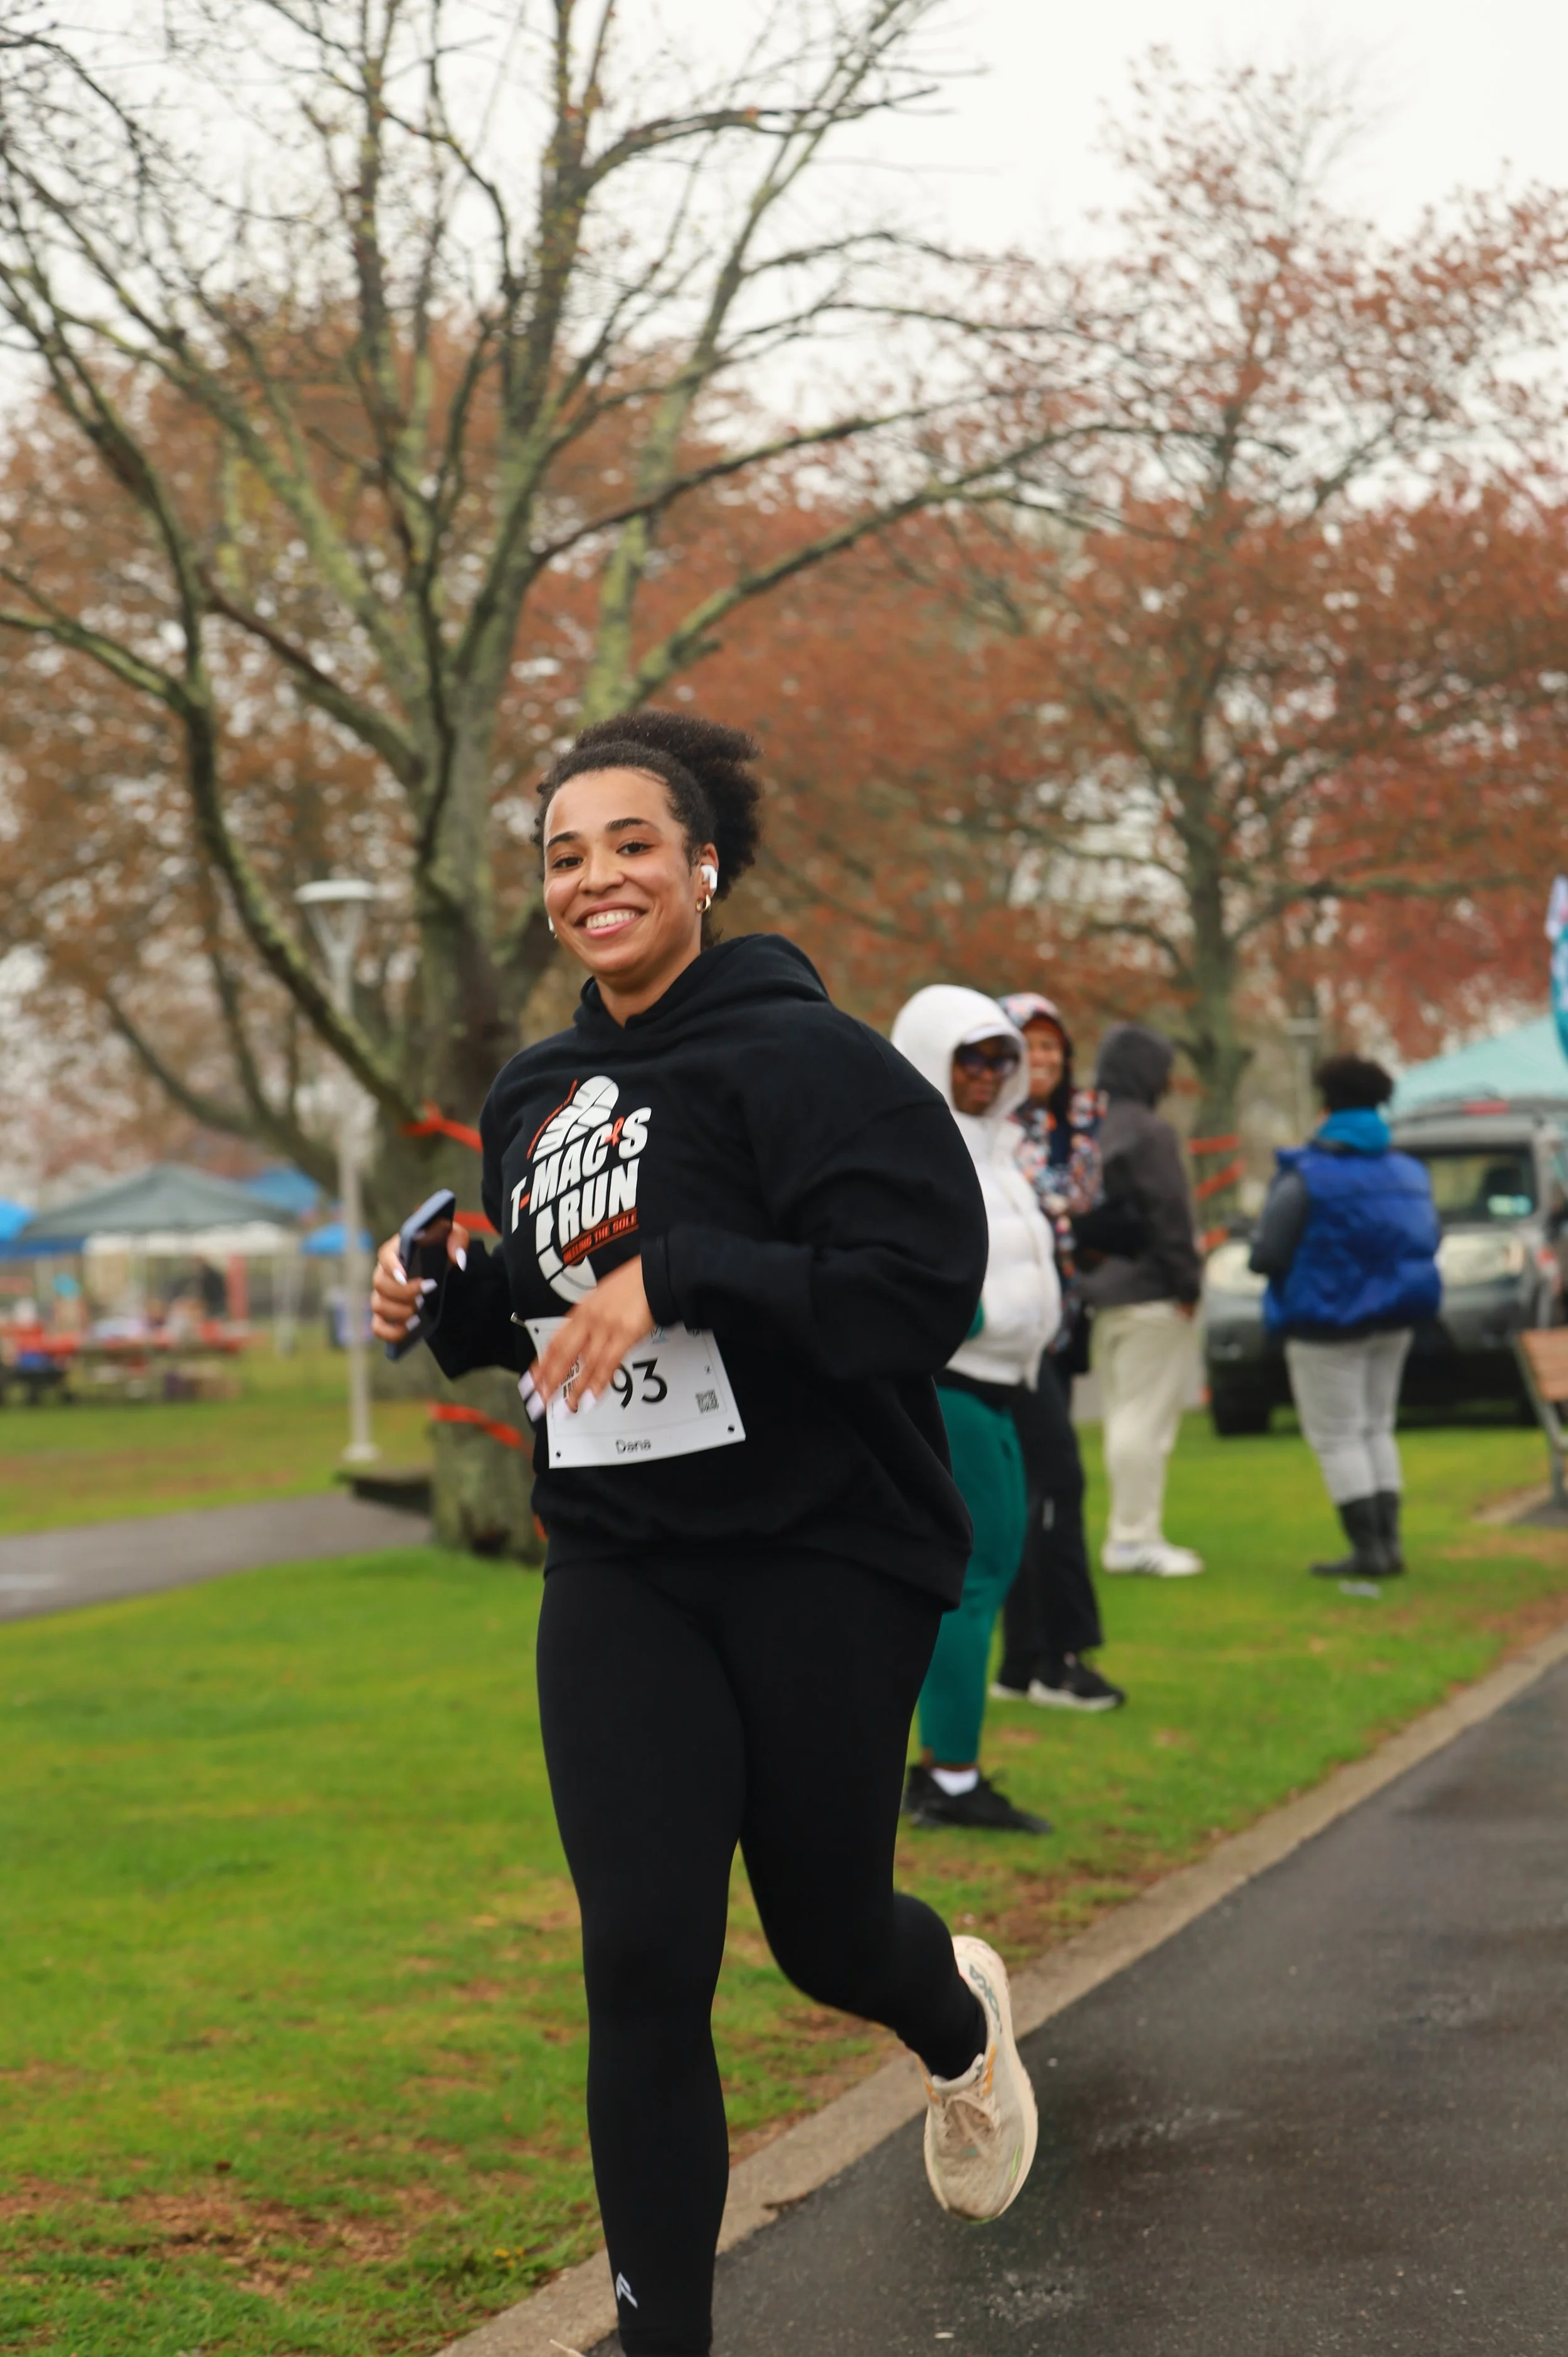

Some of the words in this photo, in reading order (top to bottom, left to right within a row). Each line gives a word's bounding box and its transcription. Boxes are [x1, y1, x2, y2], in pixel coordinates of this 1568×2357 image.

[559, 1158, 640, 1248] RUN
[610, 1357, 667, 1410] 93
[615, 1439, 652, 1455] Dana
